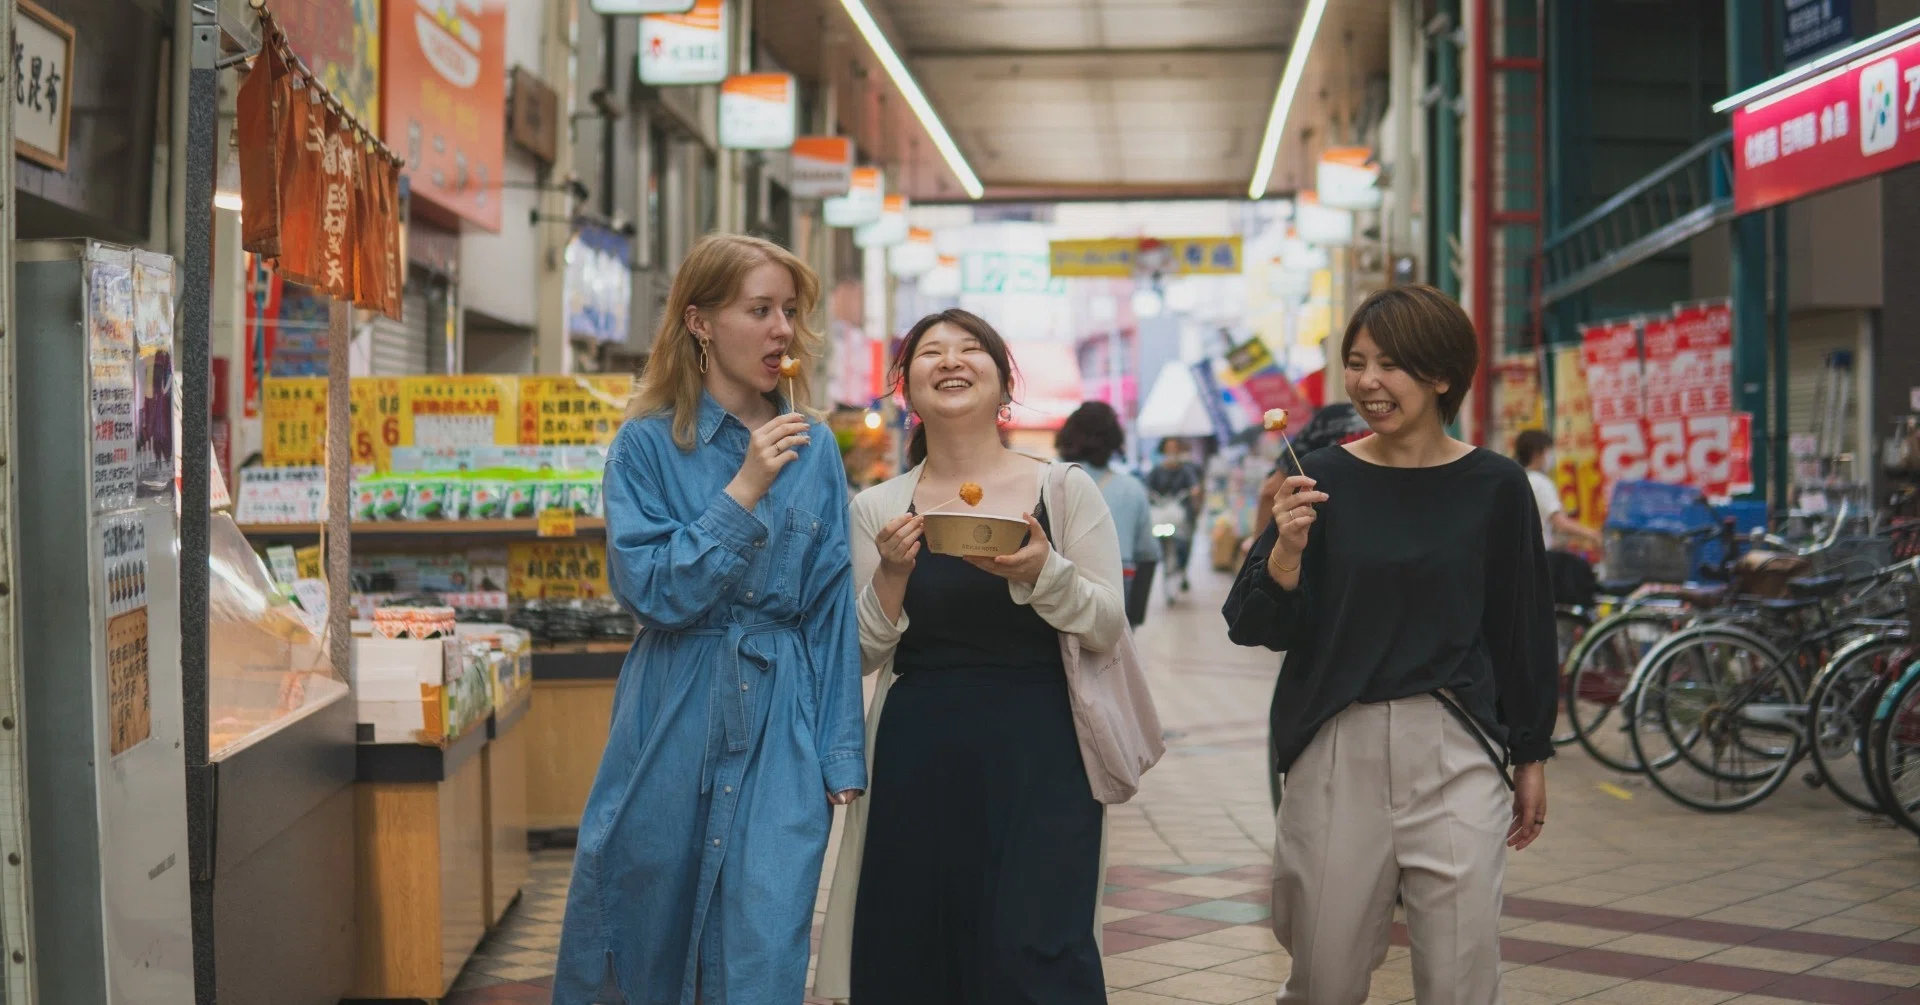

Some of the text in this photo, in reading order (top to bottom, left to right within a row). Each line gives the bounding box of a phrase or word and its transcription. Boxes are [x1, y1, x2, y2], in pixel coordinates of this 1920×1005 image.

[1780, 112, 1817, 156] 日用品
[1820, 100, 1849, 144] 食品
